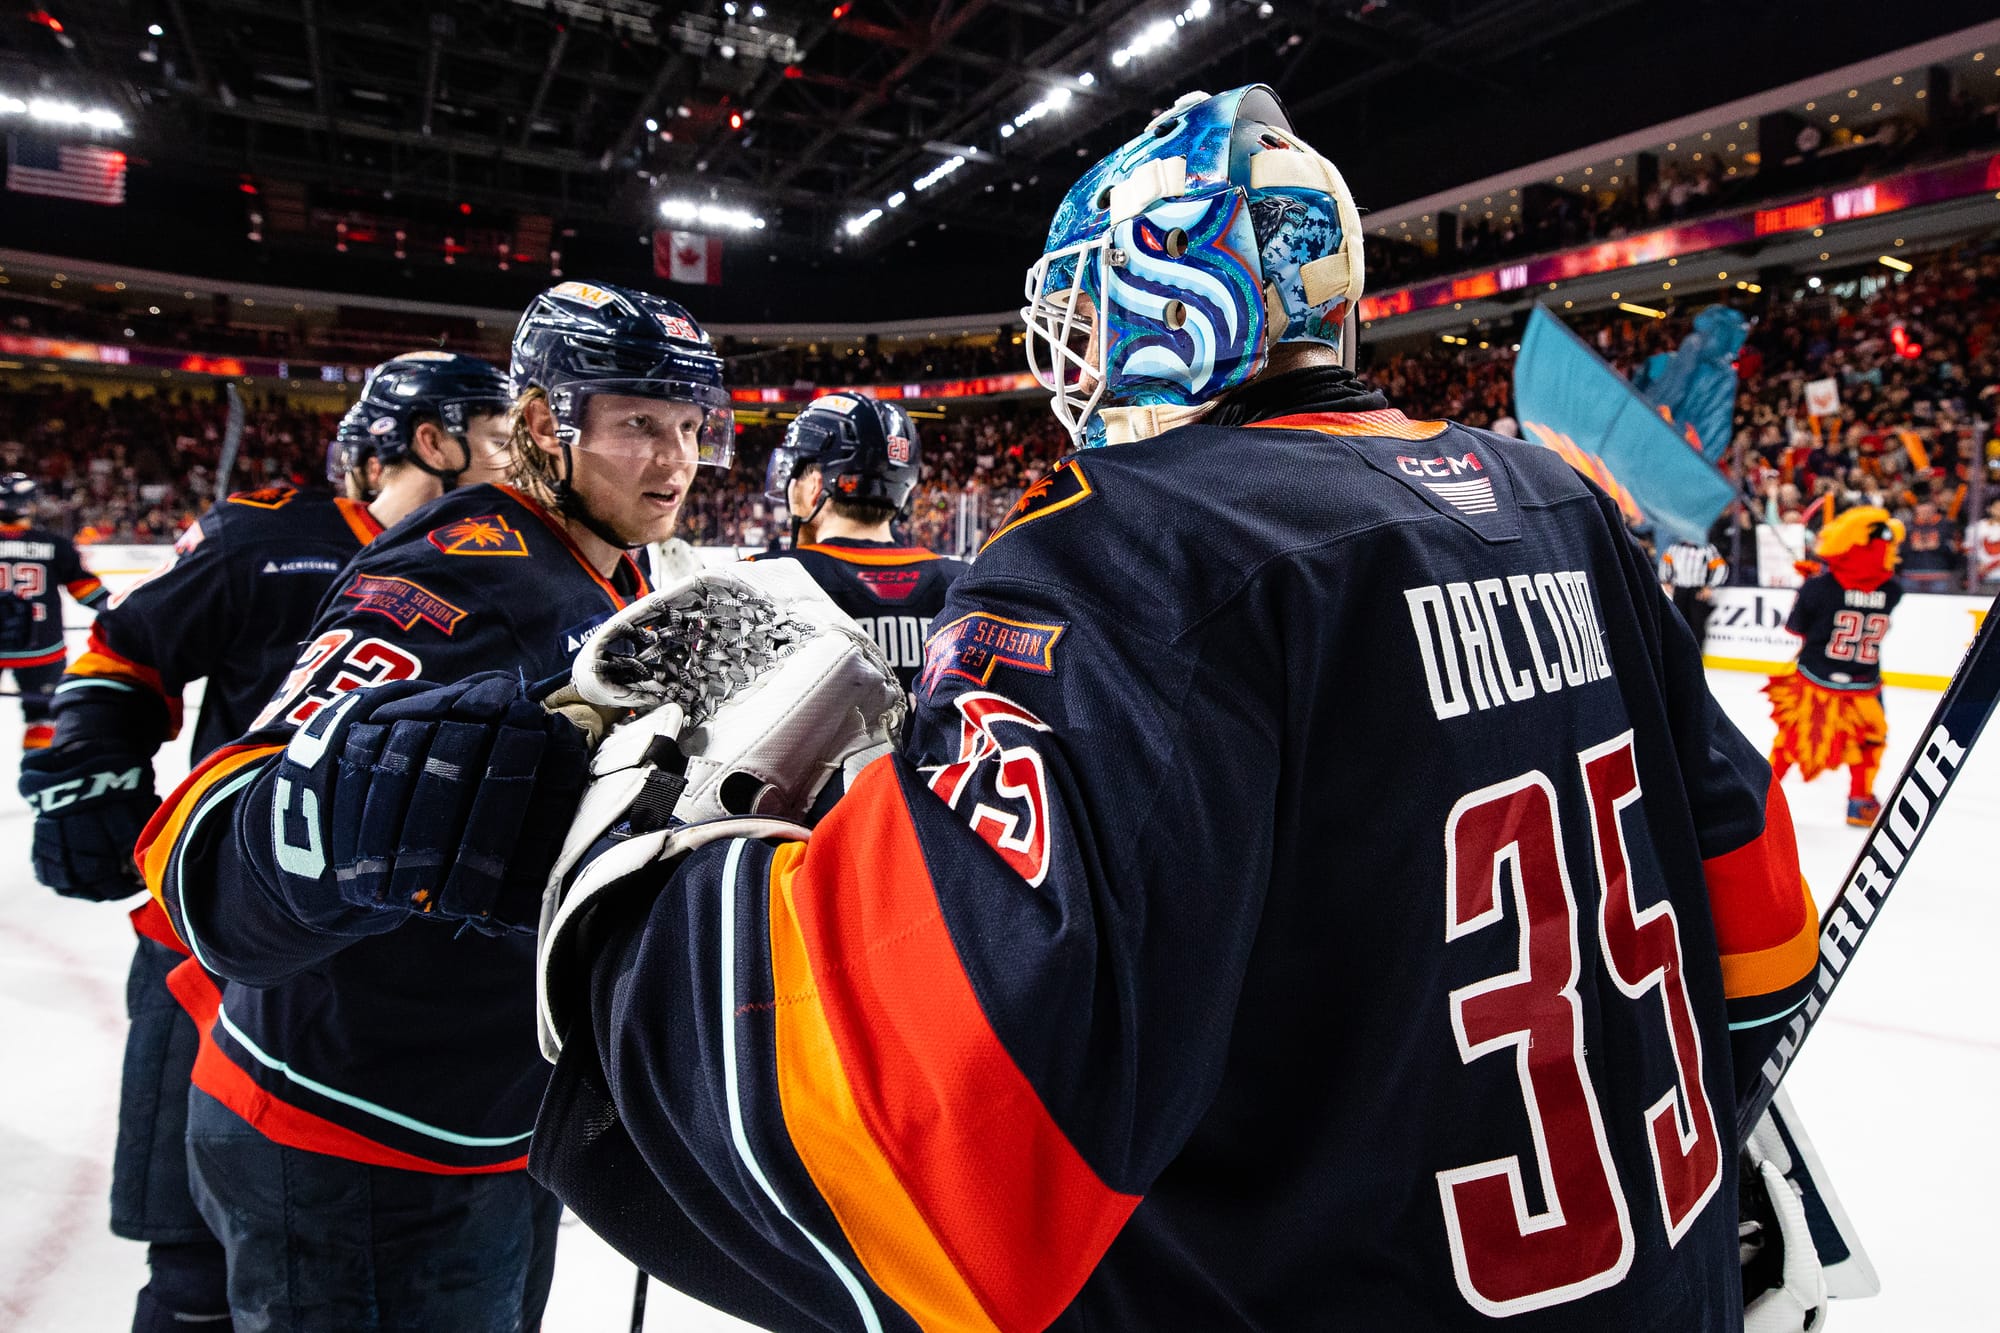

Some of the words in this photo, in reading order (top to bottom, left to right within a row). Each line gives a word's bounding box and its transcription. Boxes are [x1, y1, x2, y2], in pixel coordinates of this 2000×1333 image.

[887, 434, 911, 463] 28
[1396, 452, 1484, 478] CCM
[856, 570, 921, 582] CCM
[410, 592, 455, 624] SEASON
[973, 620, 1042, 657] SEASON
[1403, 571, 1613, 721] DACCORD
[1825, 610, 1890, 665] 22
[1761, 723, 1967, 1088] WARRIOR
[1436, 728, 1723, 1318] 35
